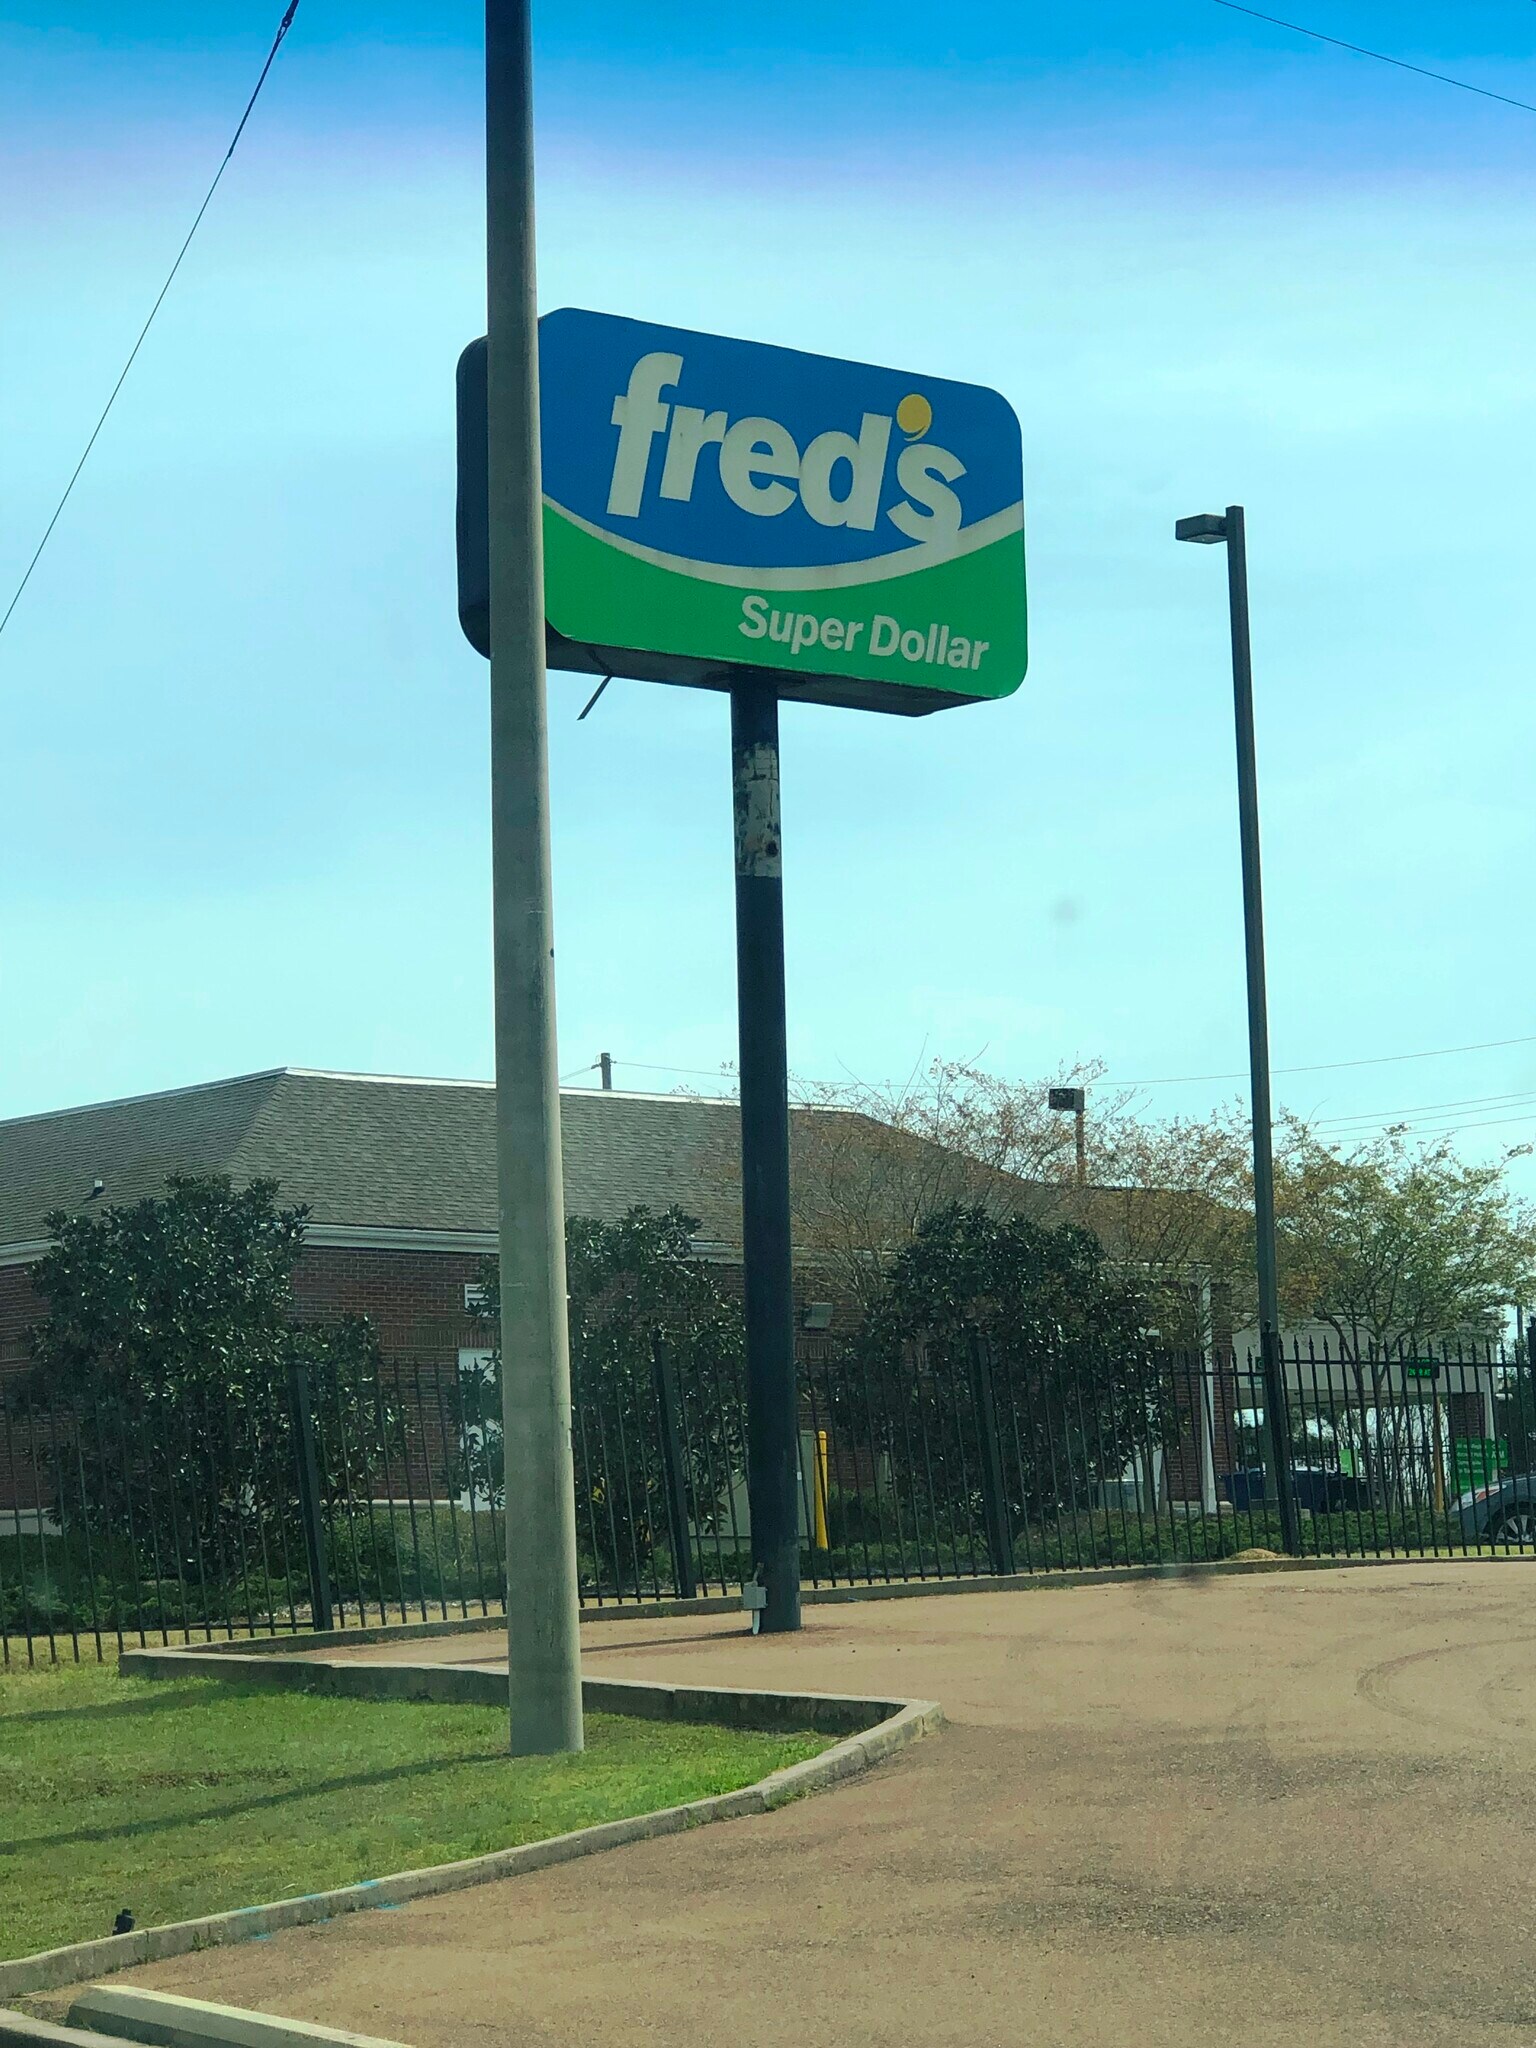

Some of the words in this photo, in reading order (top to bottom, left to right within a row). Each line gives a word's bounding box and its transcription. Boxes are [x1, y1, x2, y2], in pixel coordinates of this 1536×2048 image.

[606, 352, 967, 546] fred's
[738, 595, 864, 655] Super
[868, 615, 990, 671] Dollar
